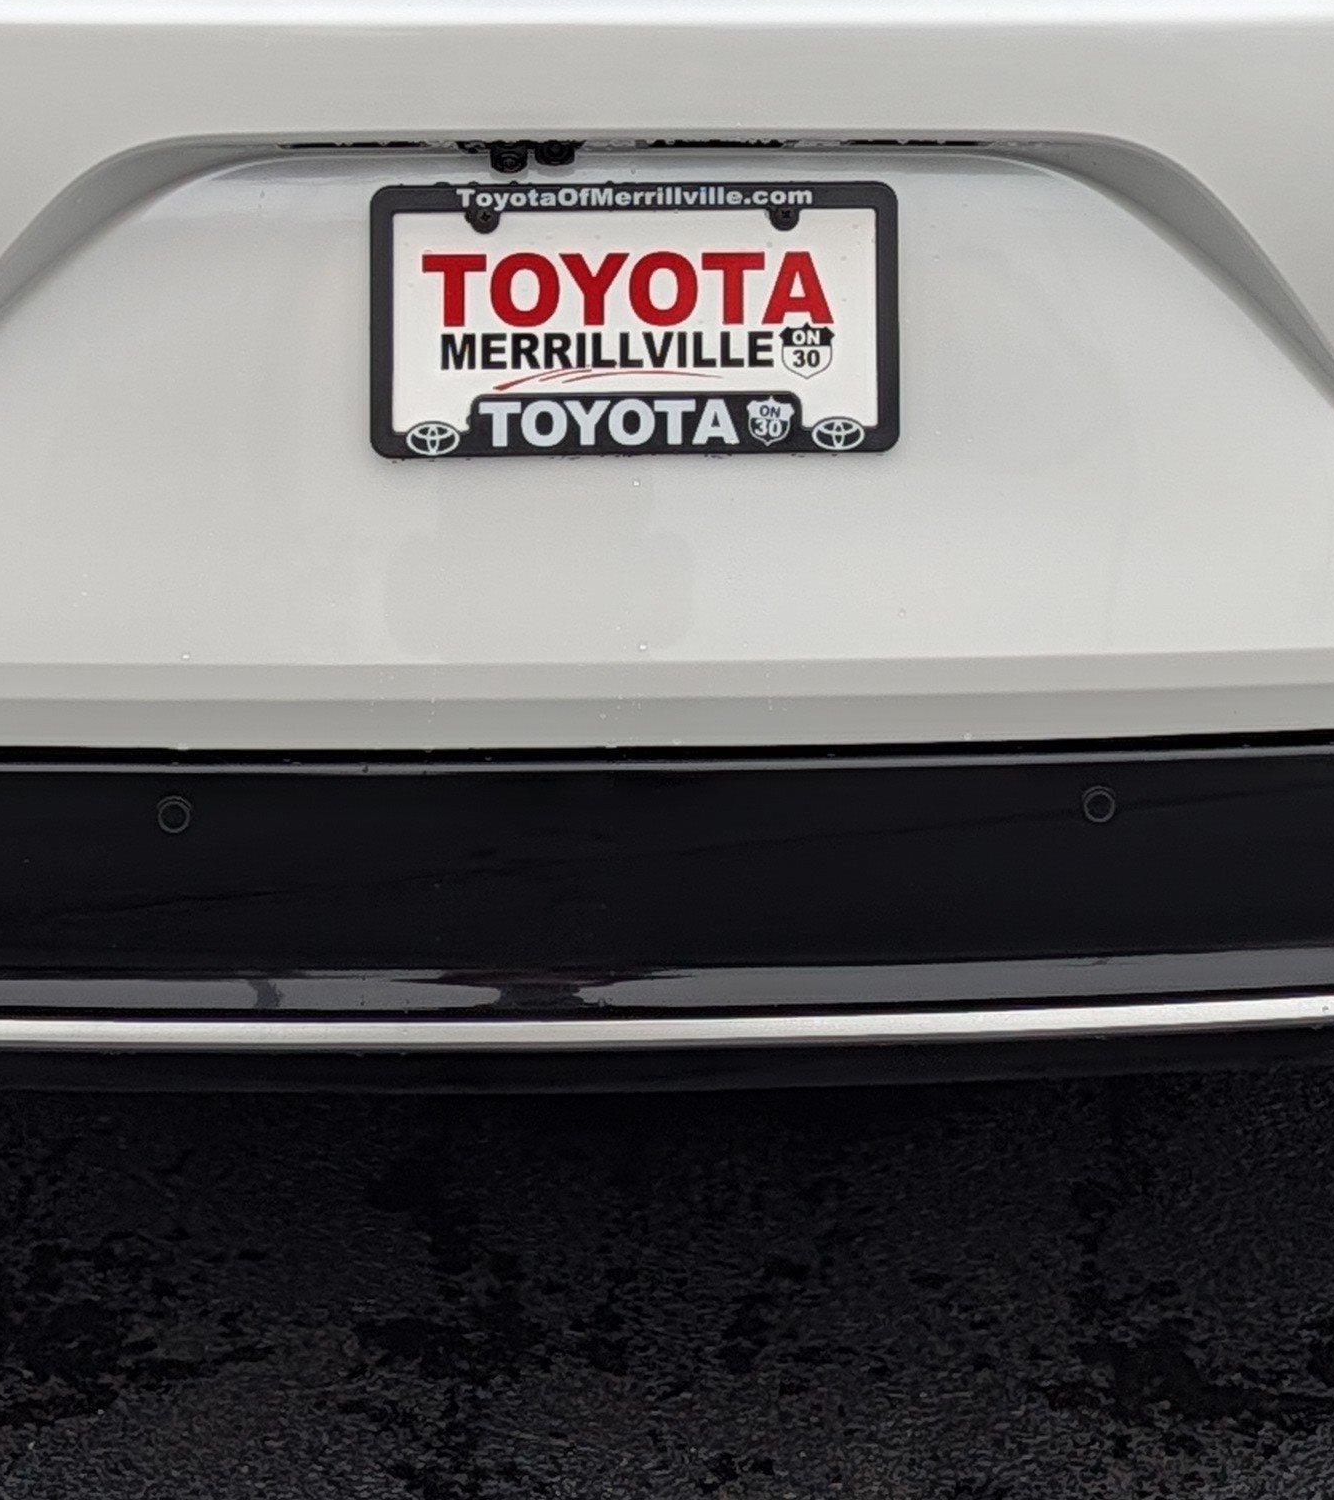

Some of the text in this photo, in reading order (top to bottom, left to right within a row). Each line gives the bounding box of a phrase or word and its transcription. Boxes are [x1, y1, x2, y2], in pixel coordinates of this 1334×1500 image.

[456, 186, 813, 211] ToyotaOfMerrillville.com
[421, 251, 835, 328] TOYOTA
[791, 329, 821, 345] ON
[440, 331, 774, 370] MERRILLVILLE
[792, 350, 821, 368] 30
[759, 405, 781, 417] ON
[478, 399, 740, 447] TOYOTA
[754, 419, 783, 437] 30
